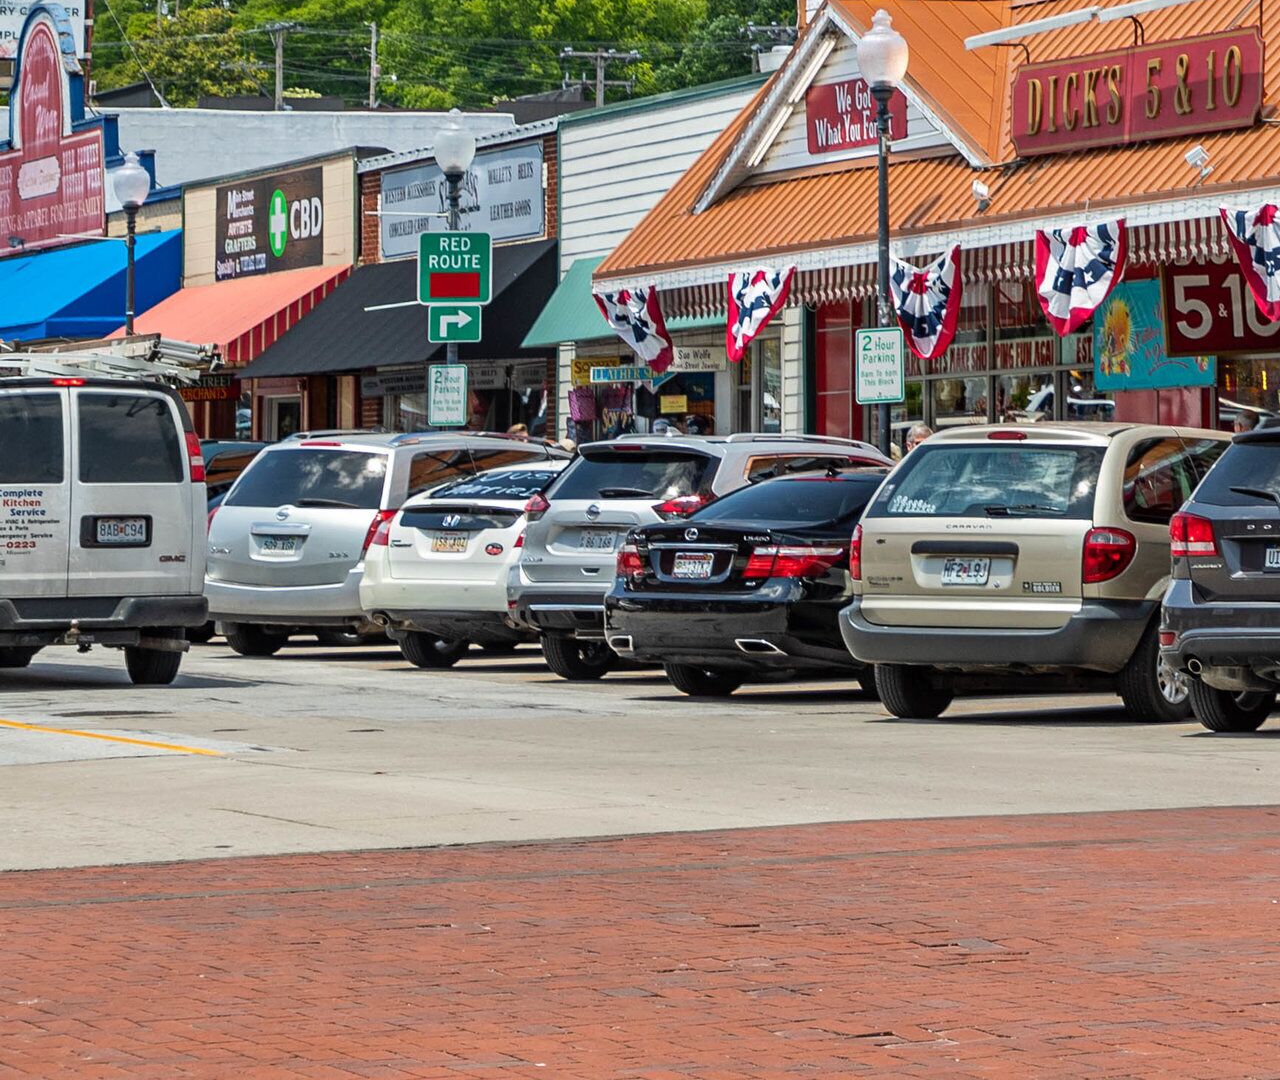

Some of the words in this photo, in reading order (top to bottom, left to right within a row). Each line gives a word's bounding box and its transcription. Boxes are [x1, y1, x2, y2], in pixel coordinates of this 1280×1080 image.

[835, 83, 852, 114] We
[855, 81, 872, 111] Got
[1026, 65, 1122, 136] DICK'S
[1145, 57, 1163, 119] 5
[1174, 53, 1193, 116] &
[1205, 45, 1243, 111] 10
[815, 117, 842, 147] What
[843, 113, 861, 143] You
[862, 110, 893, 140] Fort
[487, 165, 513, 186] WALLETS
[517, 161, 535, 180] BELTS
[490, 201, 515, 221] LEATHER
[515, 198, 533, 218] GOODS
[290, 196, 322, 240] CBD
[228, 219, 253, 236] ARTISTS
[440, 237, 471, 251] RED
[429, 254, 481, 269] ROUTE
[1173, 274, 1214, 340] 5
[1218, 302, 1228, 318] &
[863, 335, 872, 351] 2
[875, 341, 895, 351] Hour
[693, 349, 711, 360] Wolfe
[862, 354, 896, 365] Parking
[970, 342, 1015, 370] SHOPING
[1015, 340, 1033, 368] FUN
[1033, 338, 1055, 366] AGAI
[434, 371, 443, 384] 2
[180, 387, 227, 400] ERCHANTS
[434, 385, 460, 395] Parking
[2, 499, 41, 507] Kitchen
[10, 508, 46, 516] Service
[100, 523, 119, 537] 8AB
[944, 562, 963, 578] HF2
